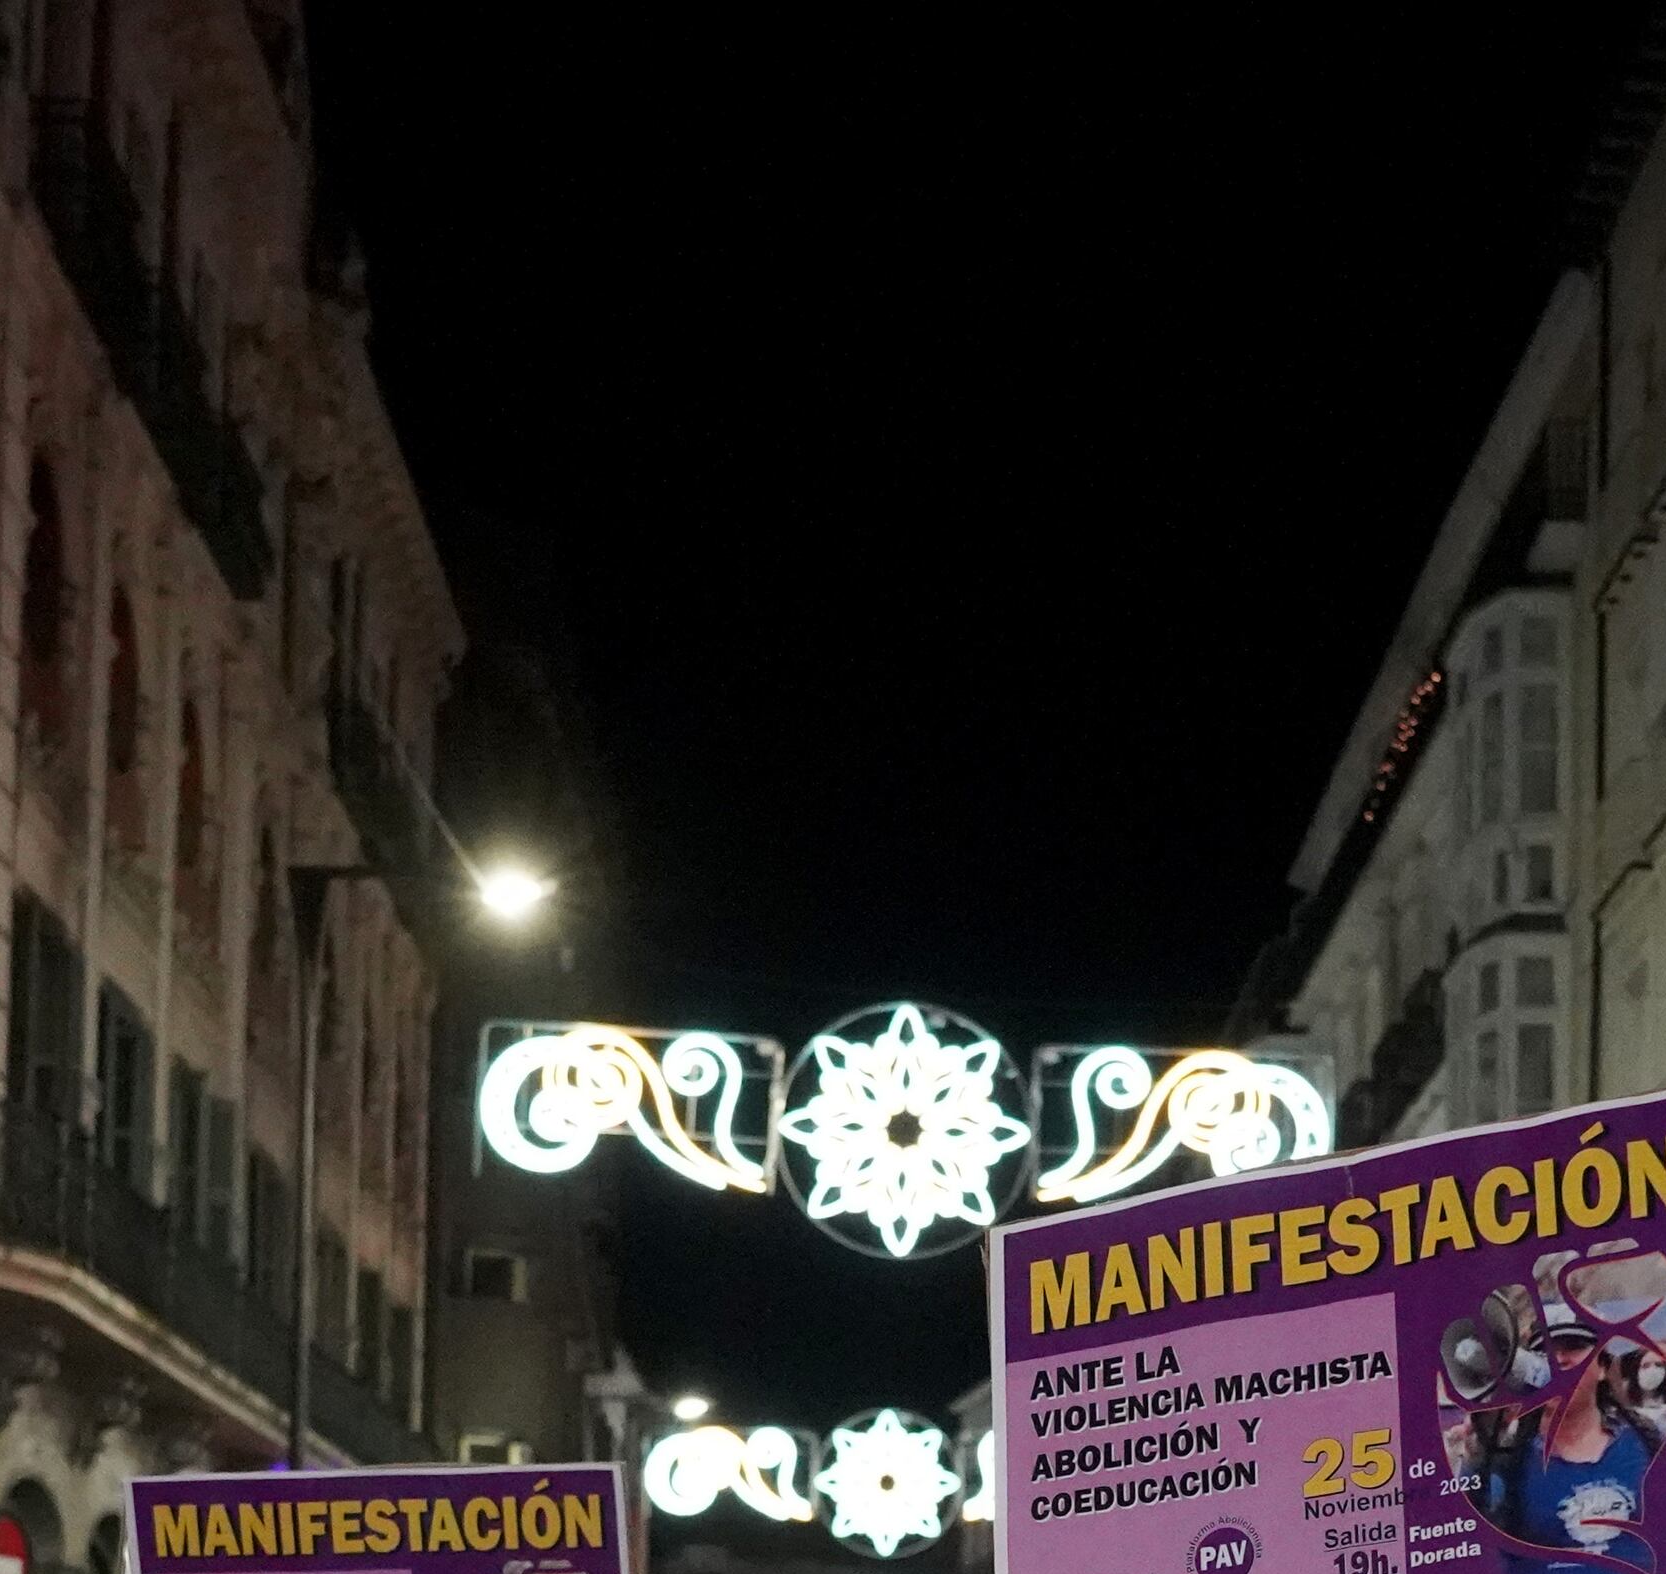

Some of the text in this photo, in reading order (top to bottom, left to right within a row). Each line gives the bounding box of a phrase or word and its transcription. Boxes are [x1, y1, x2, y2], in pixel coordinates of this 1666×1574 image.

[1030, 1346, 1182, 1403] ANTE LA
[1030, 1351, 1394, 1439] VIOLENCIA MACHISTA
[1030, 1417, 1262, 1484] ABOLICIÓN Y
[1302, 1428, 1436, 1500] 25 de
[151, 1478, 604, 1559] MANIFESTACIÓN
[1030, 1457, 1259, 1523] COEDUCACIÓN
[1304, 1474, 1482, 1520] Noviemb 2023
[1199, 1540, 1248, 1571] PAV
[1324, 1521, 1397, 1550] Salida
[1409, 1516, 1477, 1543] Fuente
[1410, 1541, 1482, 1568] Dorada
